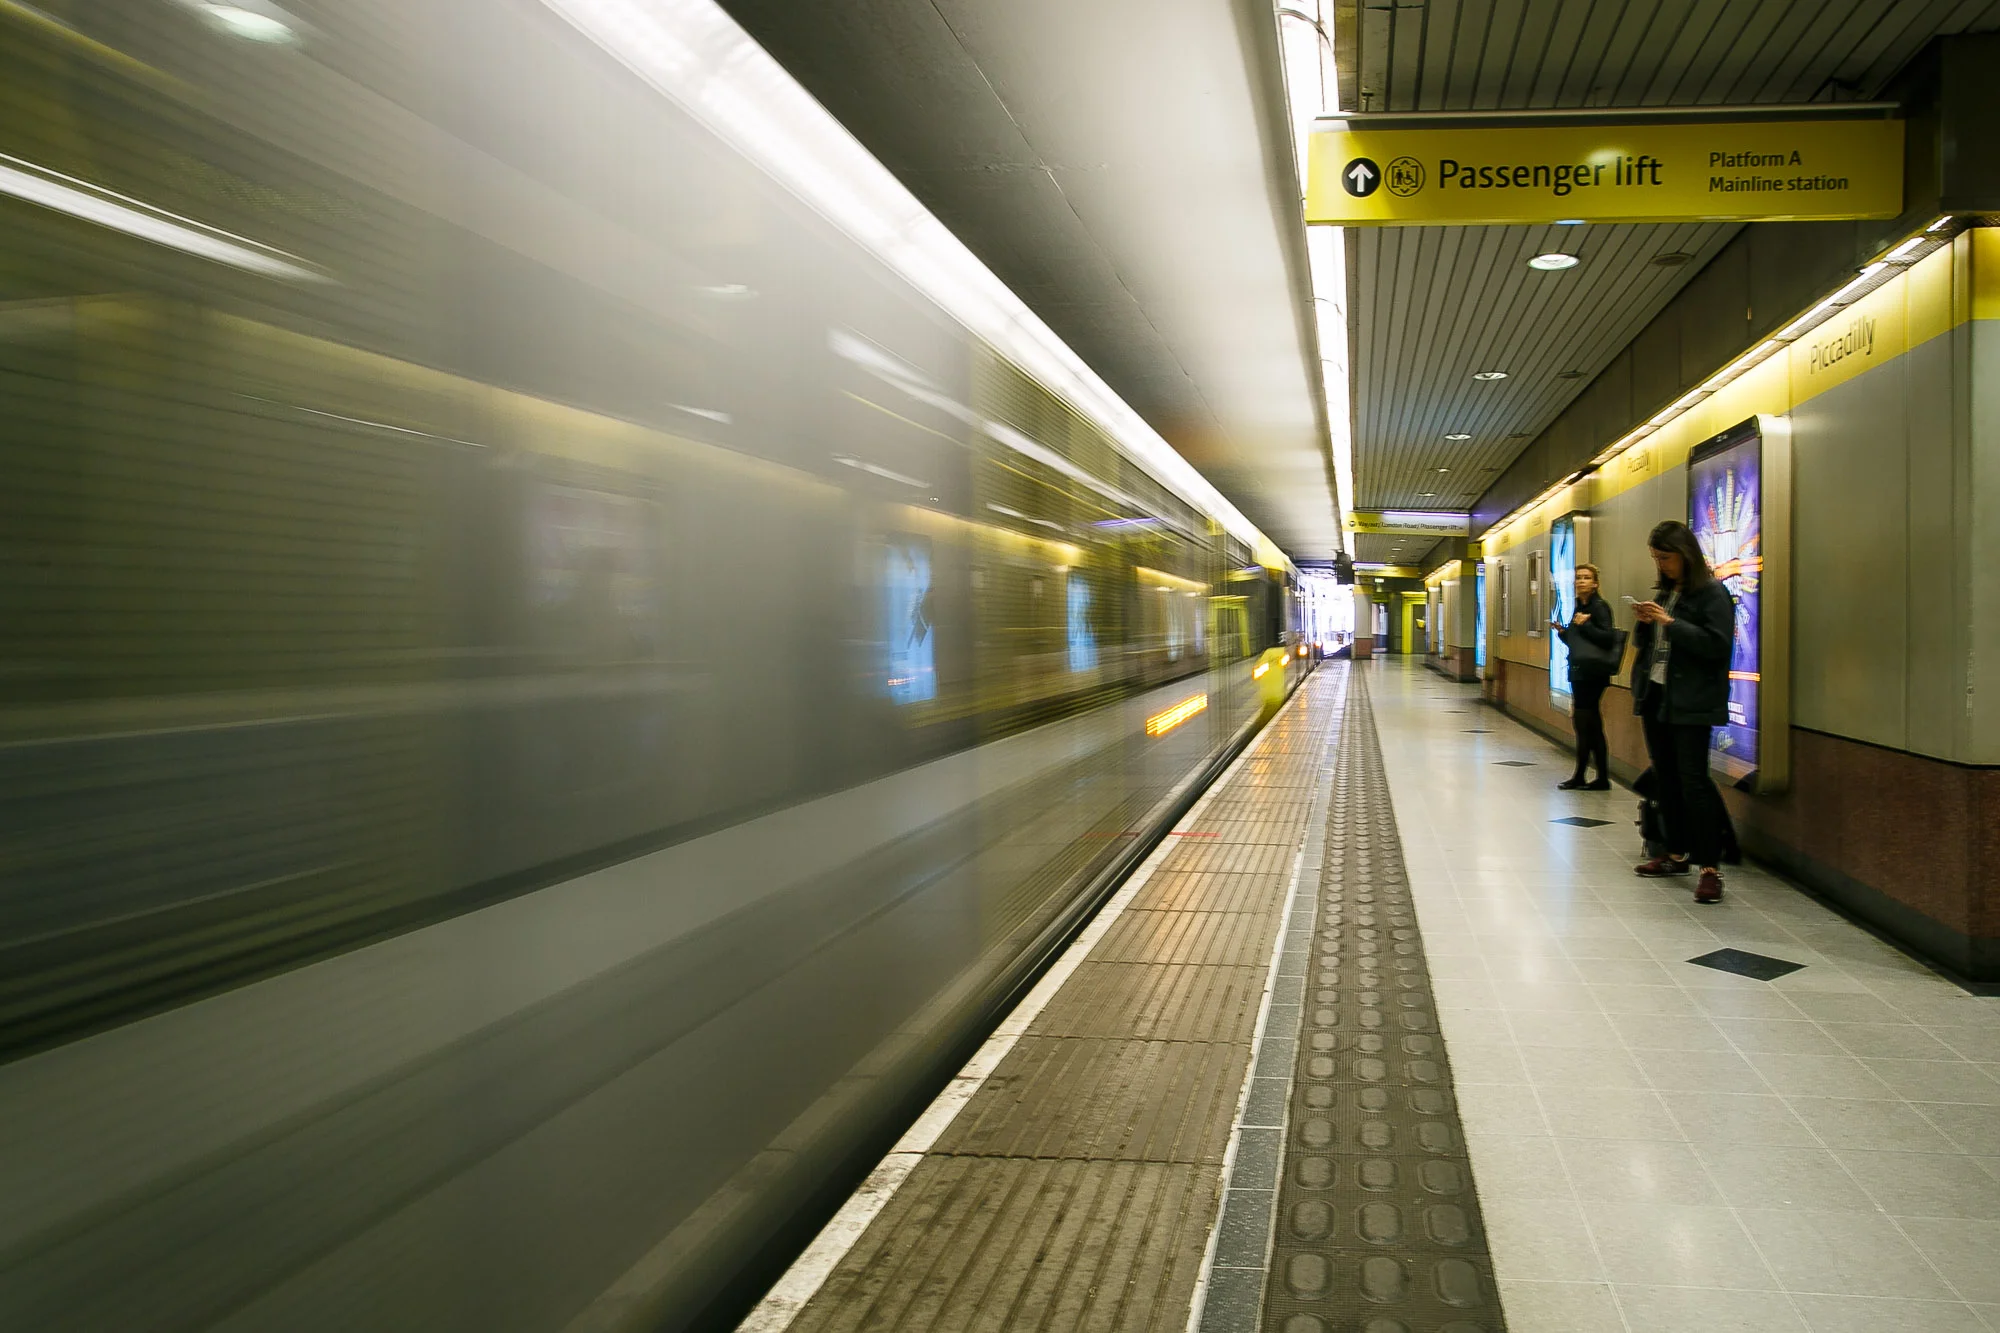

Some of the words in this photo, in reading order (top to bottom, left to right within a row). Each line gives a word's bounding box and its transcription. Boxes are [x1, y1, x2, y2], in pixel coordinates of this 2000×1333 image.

[1709, 151, 1784, 168] Platform
[1788, 150, 1802, 166] A
[1439, 159, 1606, 196] Passenger
[1615, 155, 1663, 186] lift
[1709, 176, 1784, 192] Mainline
[1787, 175, 1849, 191] station
[1810, 315, 1876, 375] Piccadilly
